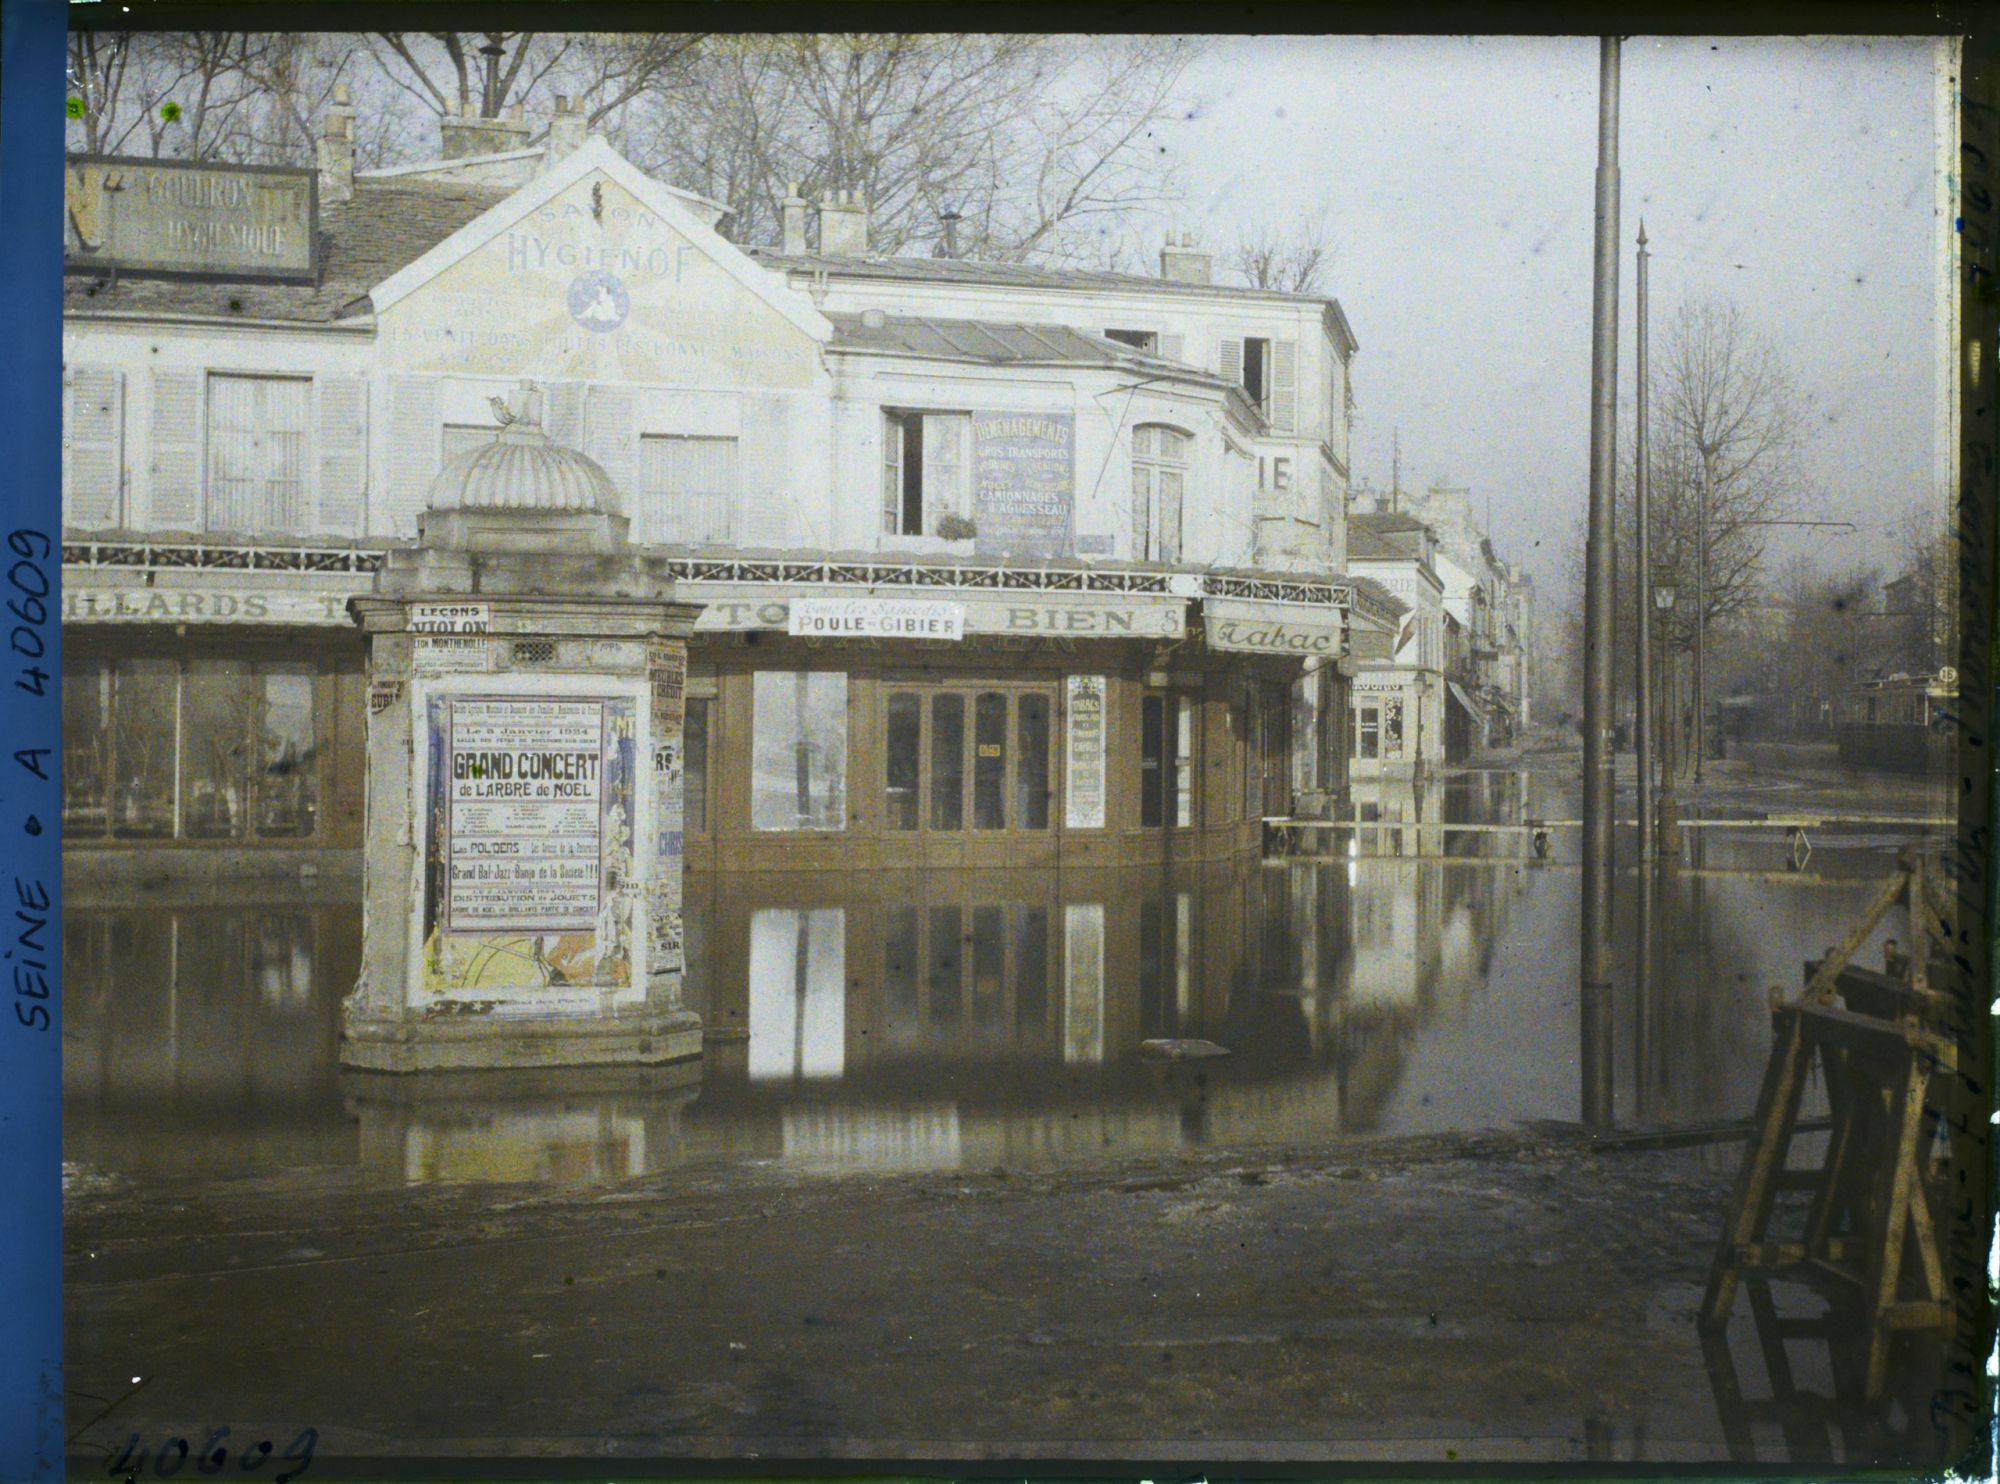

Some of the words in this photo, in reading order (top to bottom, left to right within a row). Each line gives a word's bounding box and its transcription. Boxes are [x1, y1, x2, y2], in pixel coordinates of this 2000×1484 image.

[538, 200, 657, 231] SAON
[412, 620, 488, 634] VIOLON
[1005, 607, 1134, 633] BIEN
[1217, 622, 1332, 653] Tabac
[453, 752, 514, 780] GRAND
[517, 752, 599, 780] CONCERT
[459, 783, 472, 797] de
[536, 783, 550, 797] de
[452, 864, 476, 880] Grand
[539, 866, 548, 880] de
[550, 863, 558, 879] la
